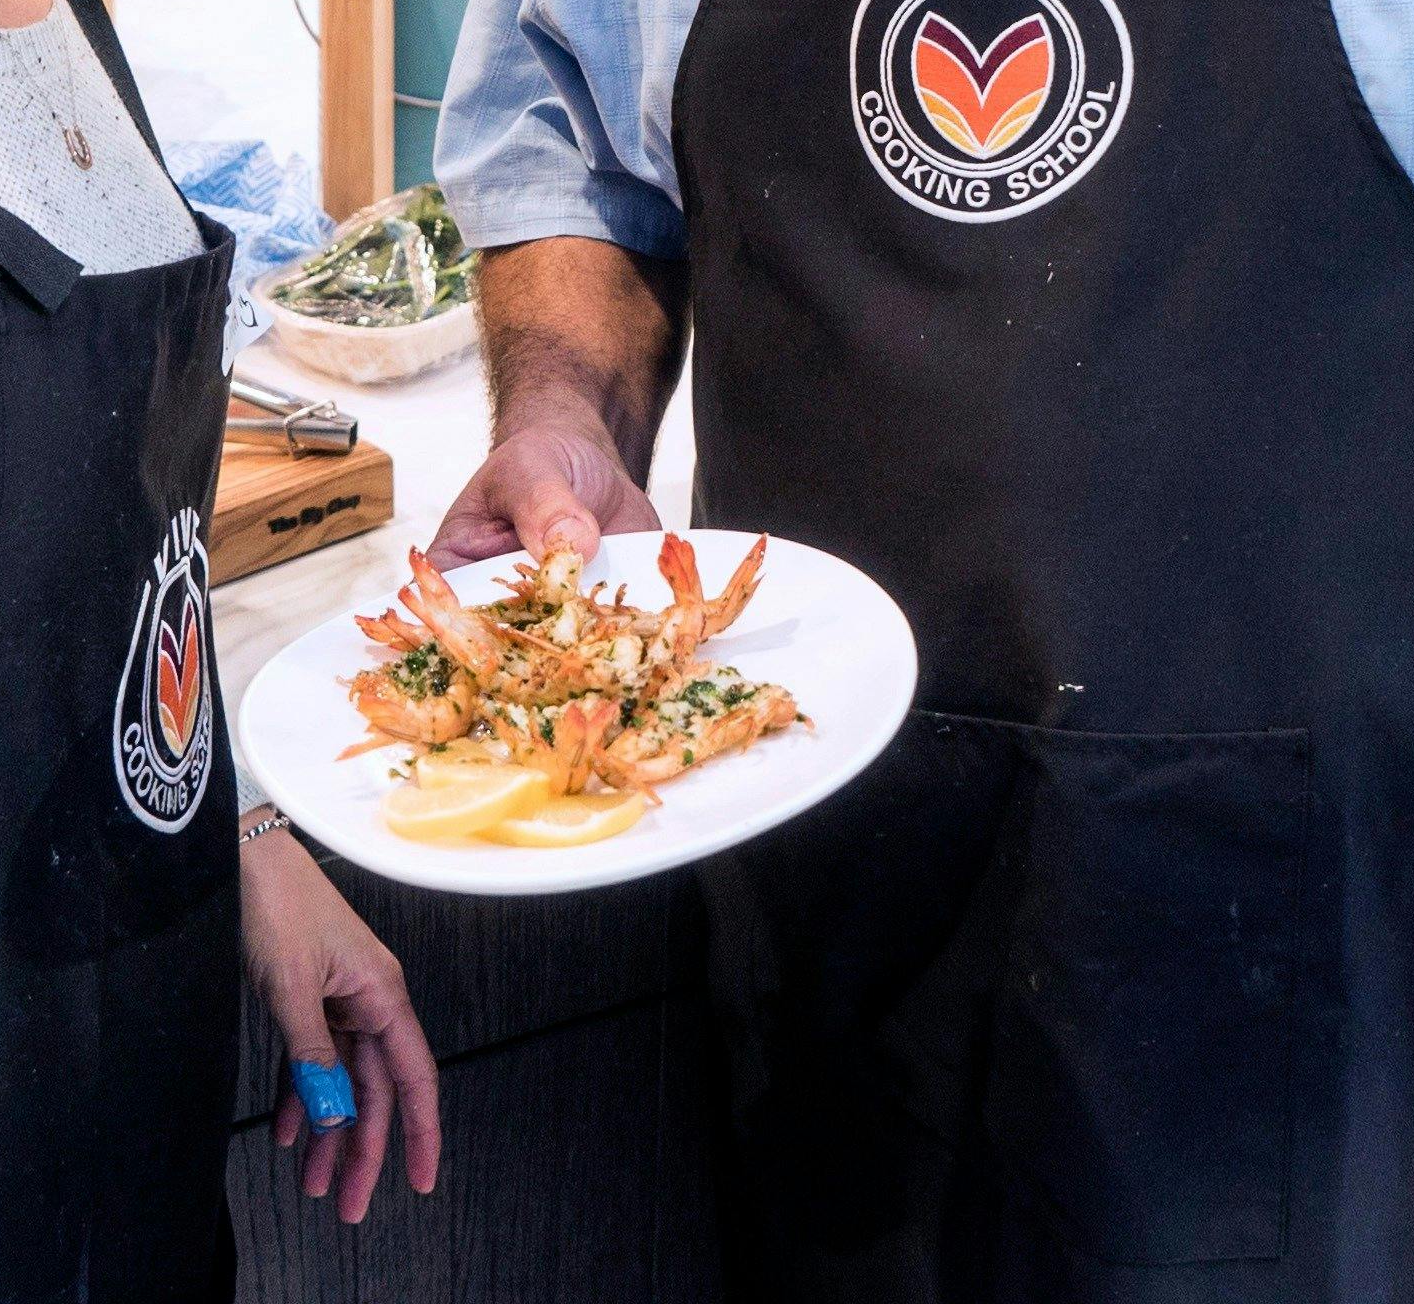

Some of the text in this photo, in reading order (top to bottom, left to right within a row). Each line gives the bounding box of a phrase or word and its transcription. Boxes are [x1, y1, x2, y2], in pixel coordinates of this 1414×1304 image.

[860, 81, 1116, 207] COOKING SCHOOL
[153, 506, 201, 585] VIVE
[123, 722, 189, 815] COOKING
